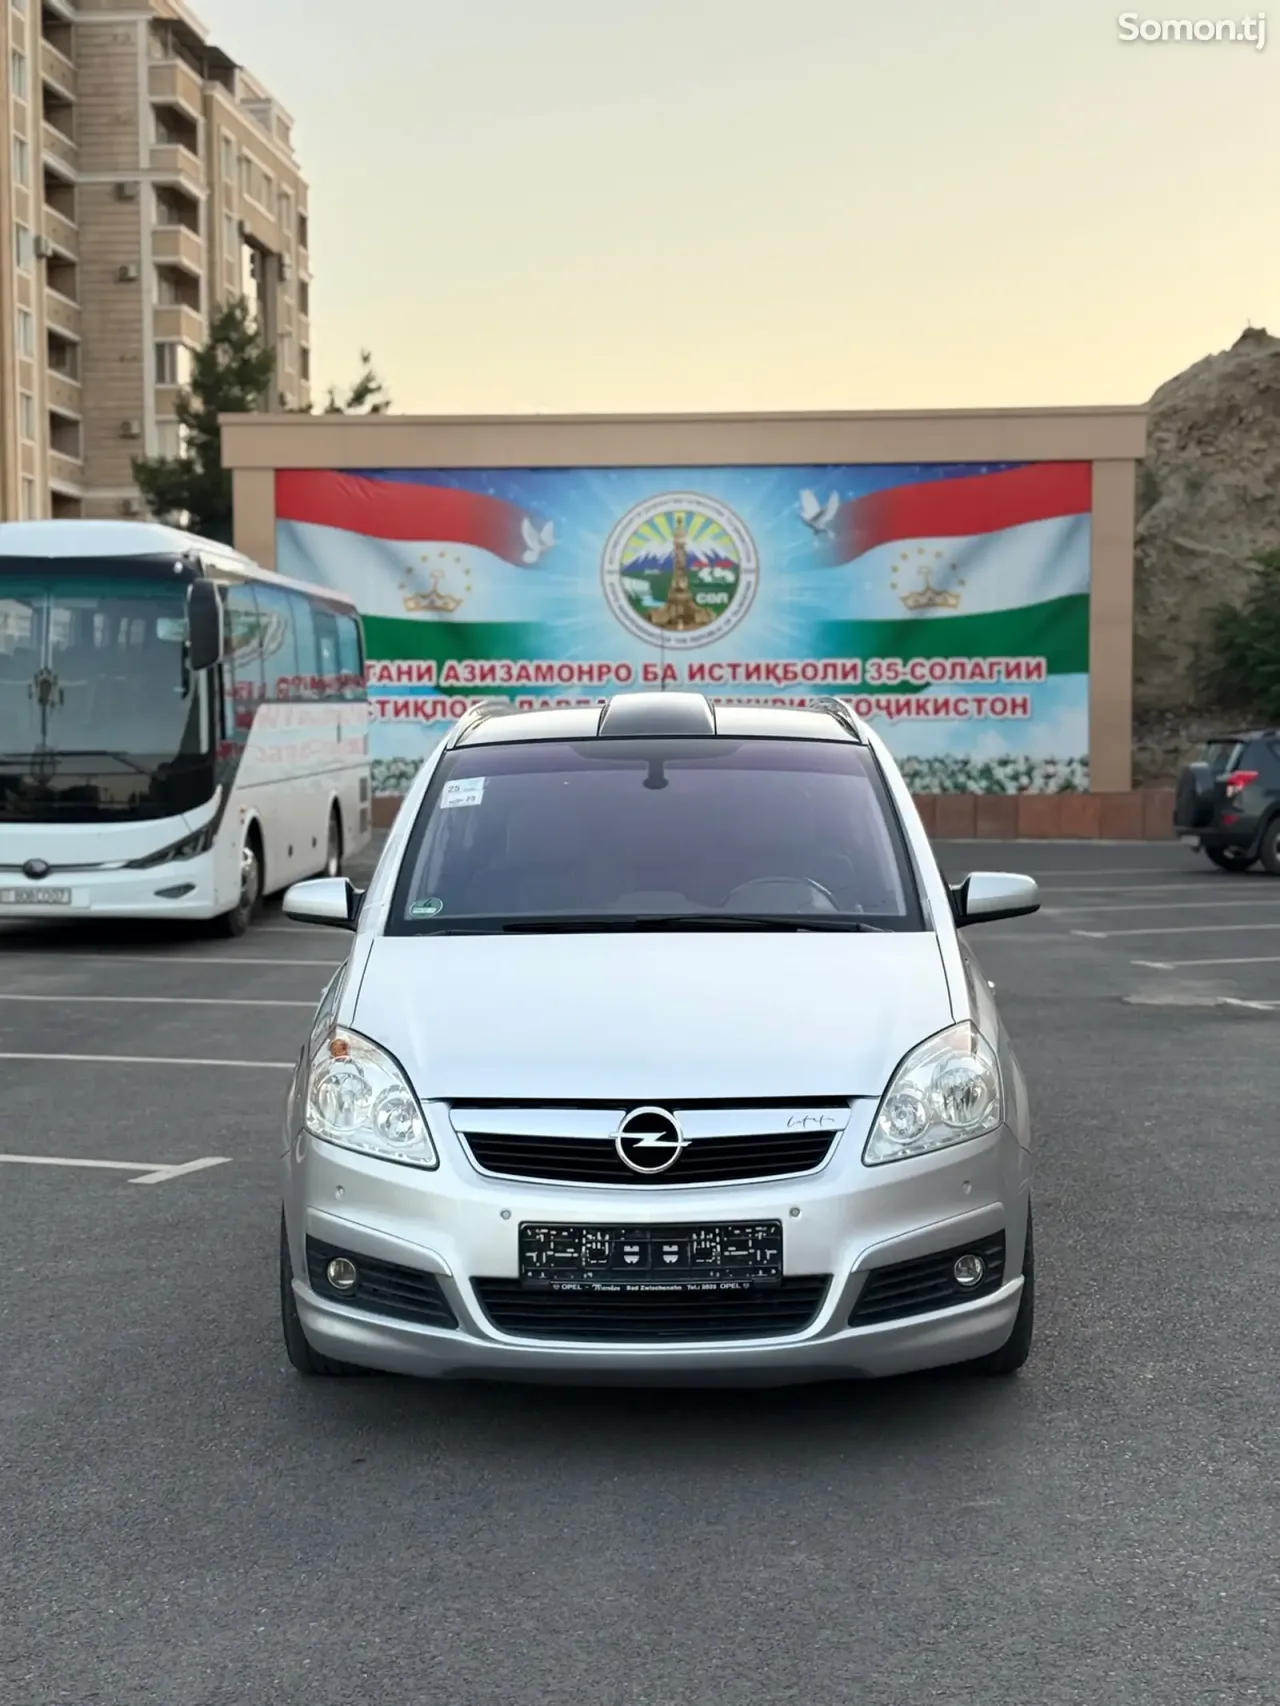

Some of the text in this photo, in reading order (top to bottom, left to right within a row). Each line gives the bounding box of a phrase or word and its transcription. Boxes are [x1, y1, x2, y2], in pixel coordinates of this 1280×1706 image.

[443, 663, 633, 683] АЗИЗАМОНРО
[641, 663, 678, 682] БА
[688, 662, 858, 684] ИСТИҚБОЛИ
[867, 660, 1044, 682] 35-СОЛАГИИ
